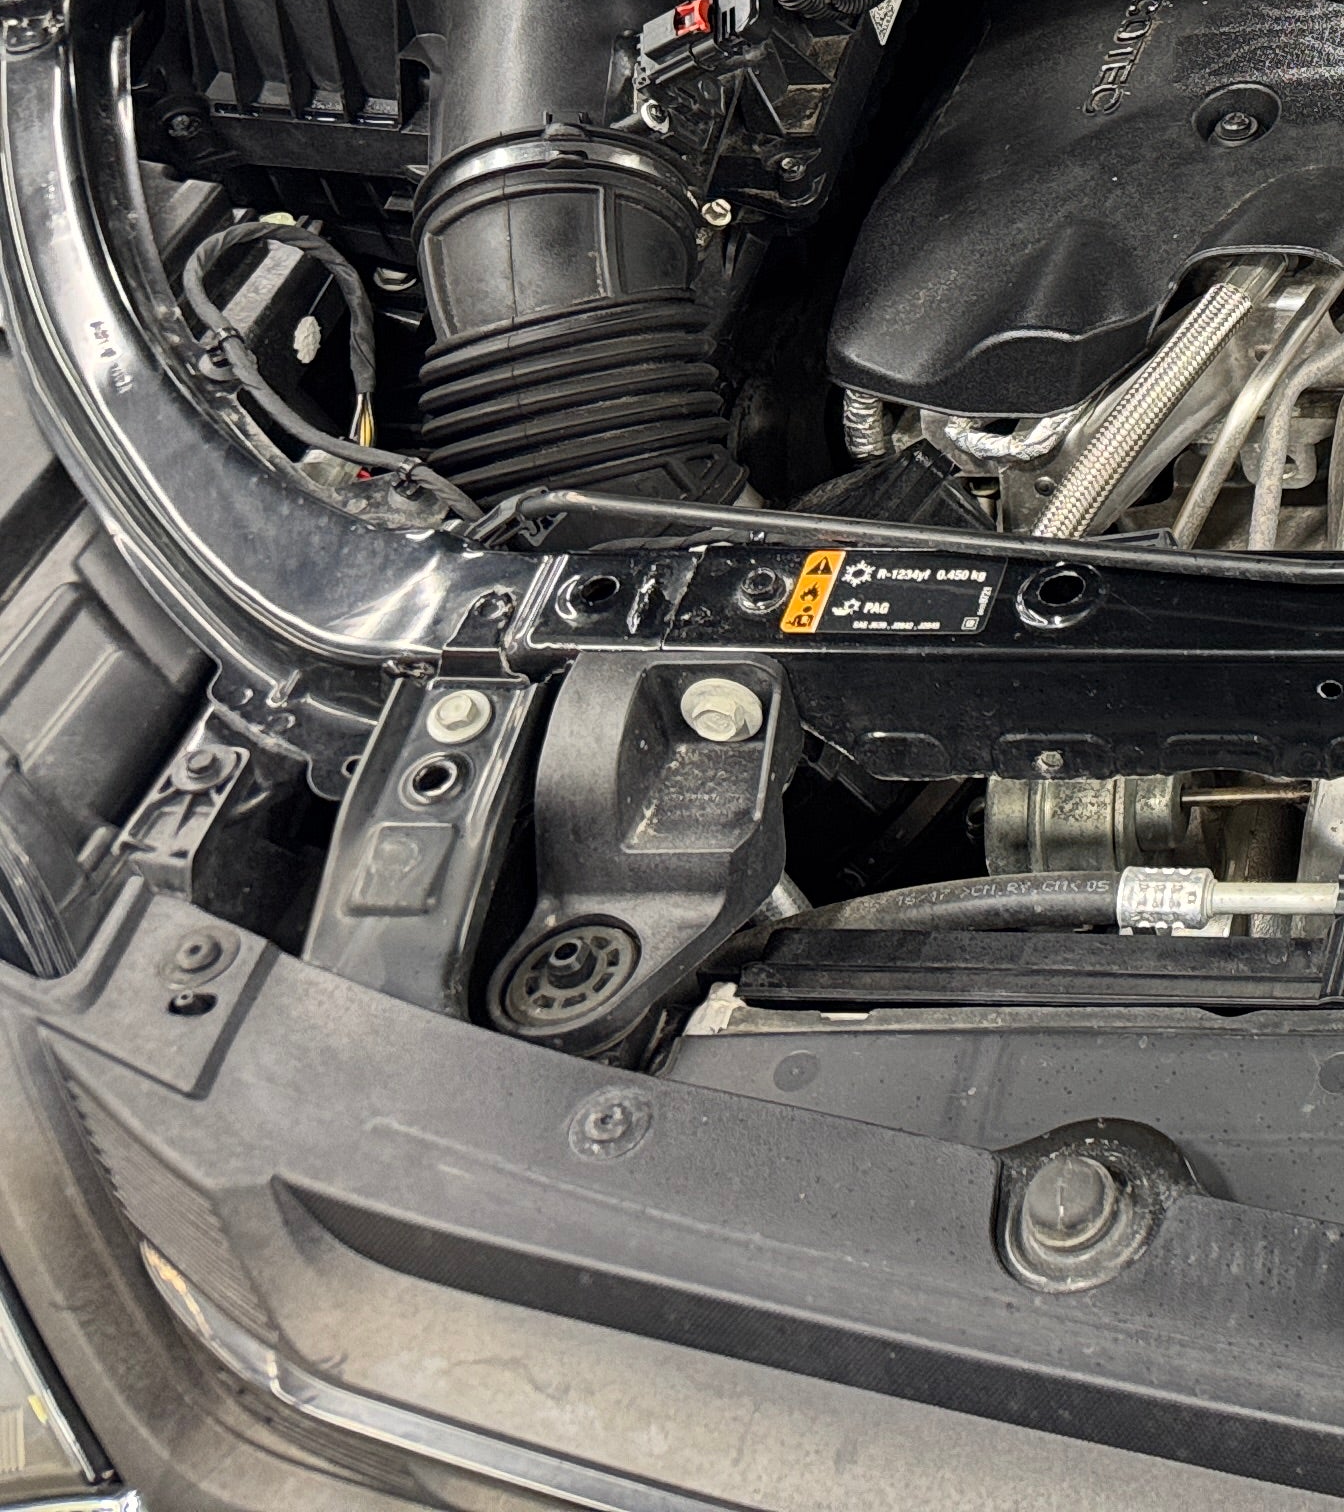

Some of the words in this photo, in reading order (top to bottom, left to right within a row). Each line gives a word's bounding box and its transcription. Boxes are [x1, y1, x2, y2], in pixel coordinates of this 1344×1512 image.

[876, 568, 932, 582] R-1234yf
[936, 569, 969, 581] 0.450
[970, 569, 987, 583] kg
[863, 602, 890, 615] PAG
